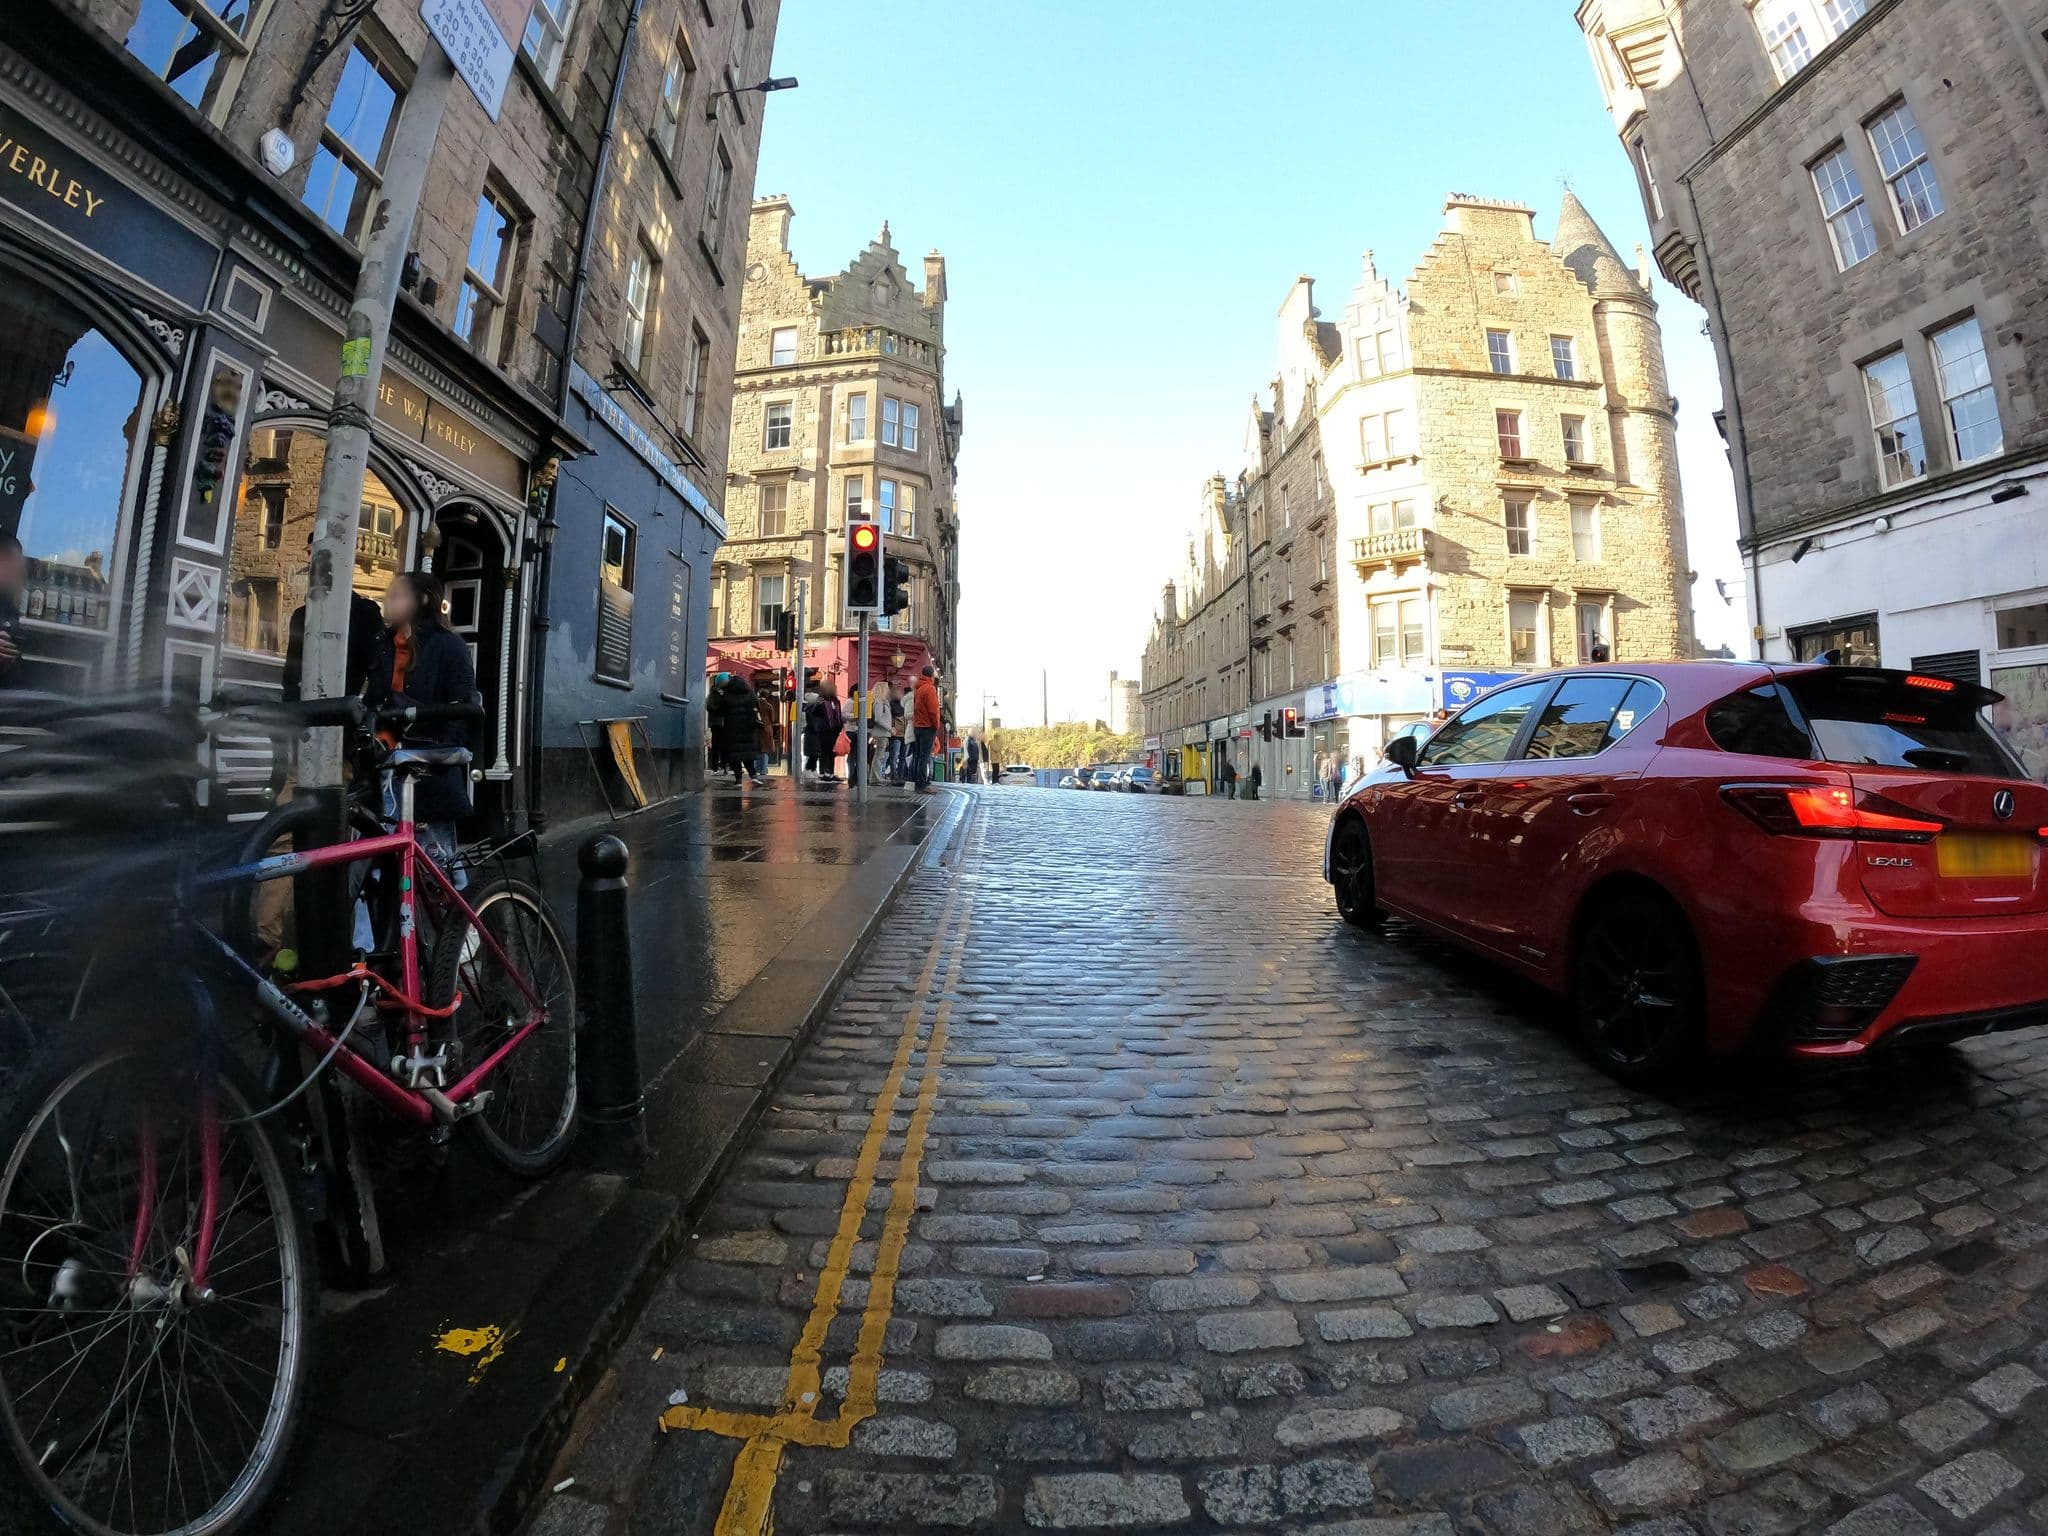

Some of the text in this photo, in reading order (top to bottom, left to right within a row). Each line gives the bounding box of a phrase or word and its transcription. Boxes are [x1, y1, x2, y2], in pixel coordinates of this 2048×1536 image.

[456, 0, 474, 33] Mon
[478, 37, 491, 58] Fri
[470, 0, 498, 49] loading
[433, 13, 455, 47] 4.00
[460, 51, 480, 84] 6.30
[478, 84, 492, 105] pm
[463, 36, 484, 69] 9.30
[482, 68, 495, 89] am
[378, 383, 476, 456] HE WAVERLEY
[600, 397, 625, 432] THE
[1867, 856, 1913, 867] LEXUS
